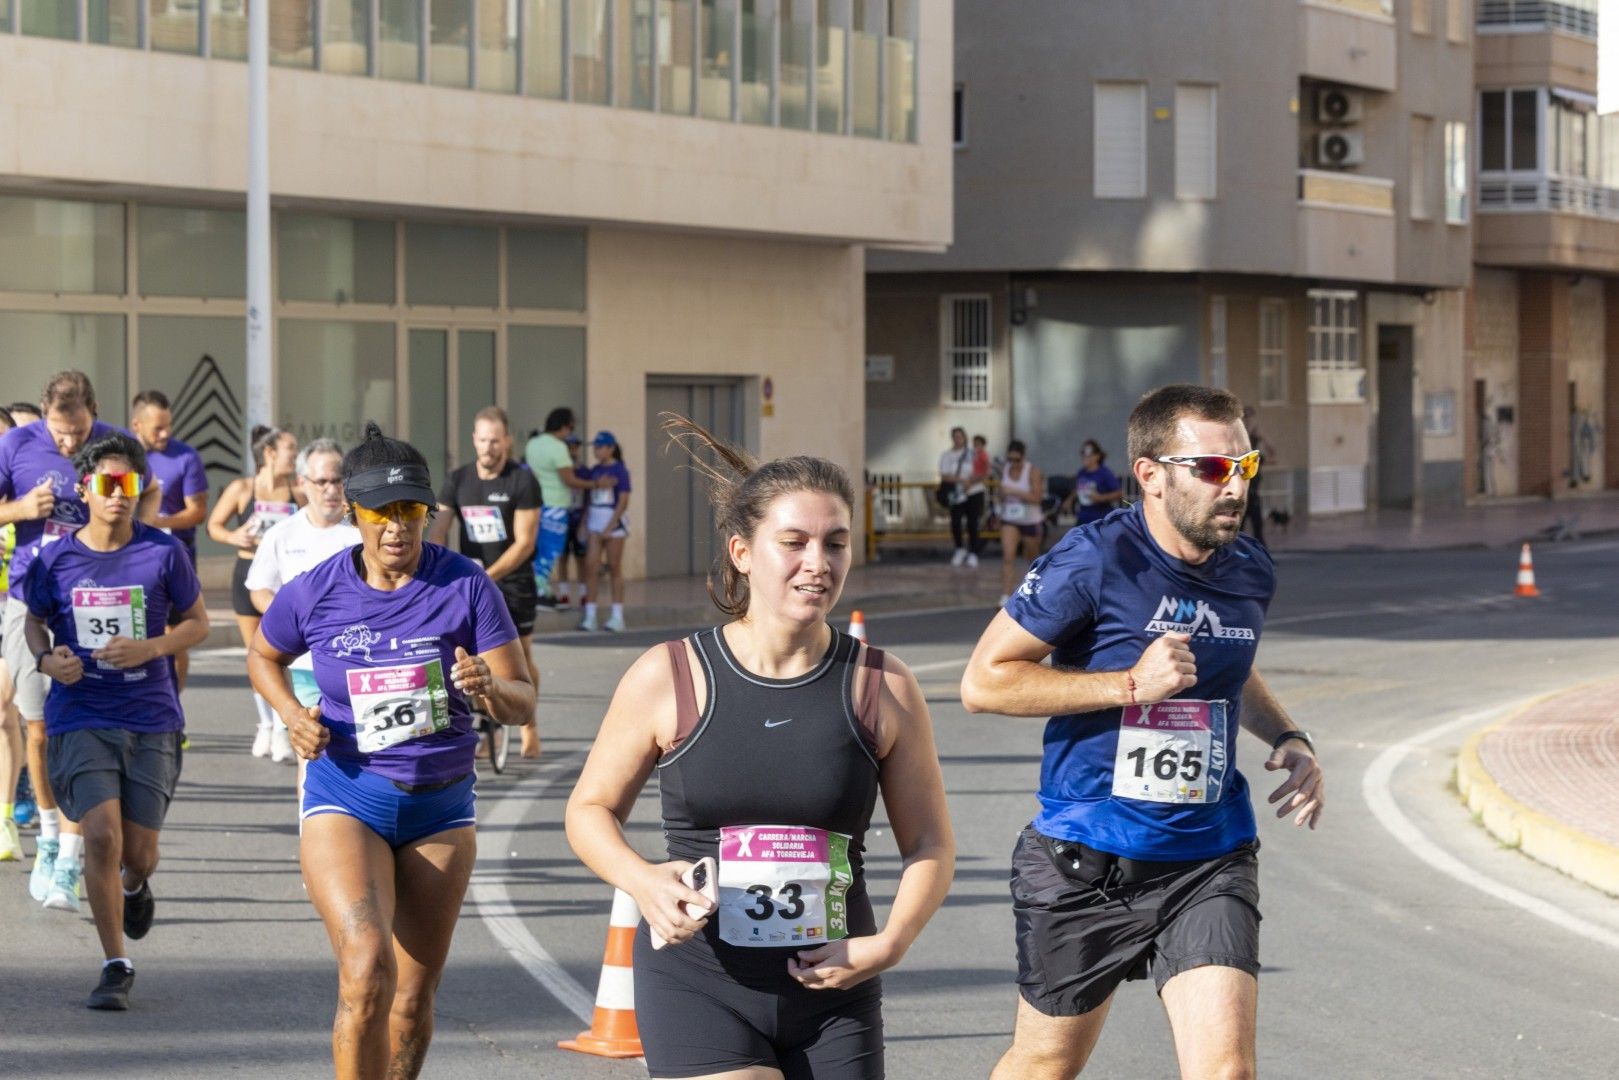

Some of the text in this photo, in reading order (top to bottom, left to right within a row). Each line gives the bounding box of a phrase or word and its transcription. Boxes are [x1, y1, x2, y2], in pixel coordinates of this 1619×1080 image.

[89, 617, 120, 636] 35
[1221, 628, 1252, 638] 2023
[360, 673, 372, 693] X
[1137, 703, 1154, 725] X
[1127, 746, 1203, 782] 165
[1208, 740, 1224, 786] 7 KM
[737, 831, 755, 858] X
[760, 850, 776, 858] AFA
[744, 883, 805, 921] 33
[828, 870, 850, 930] 3,5 KM
